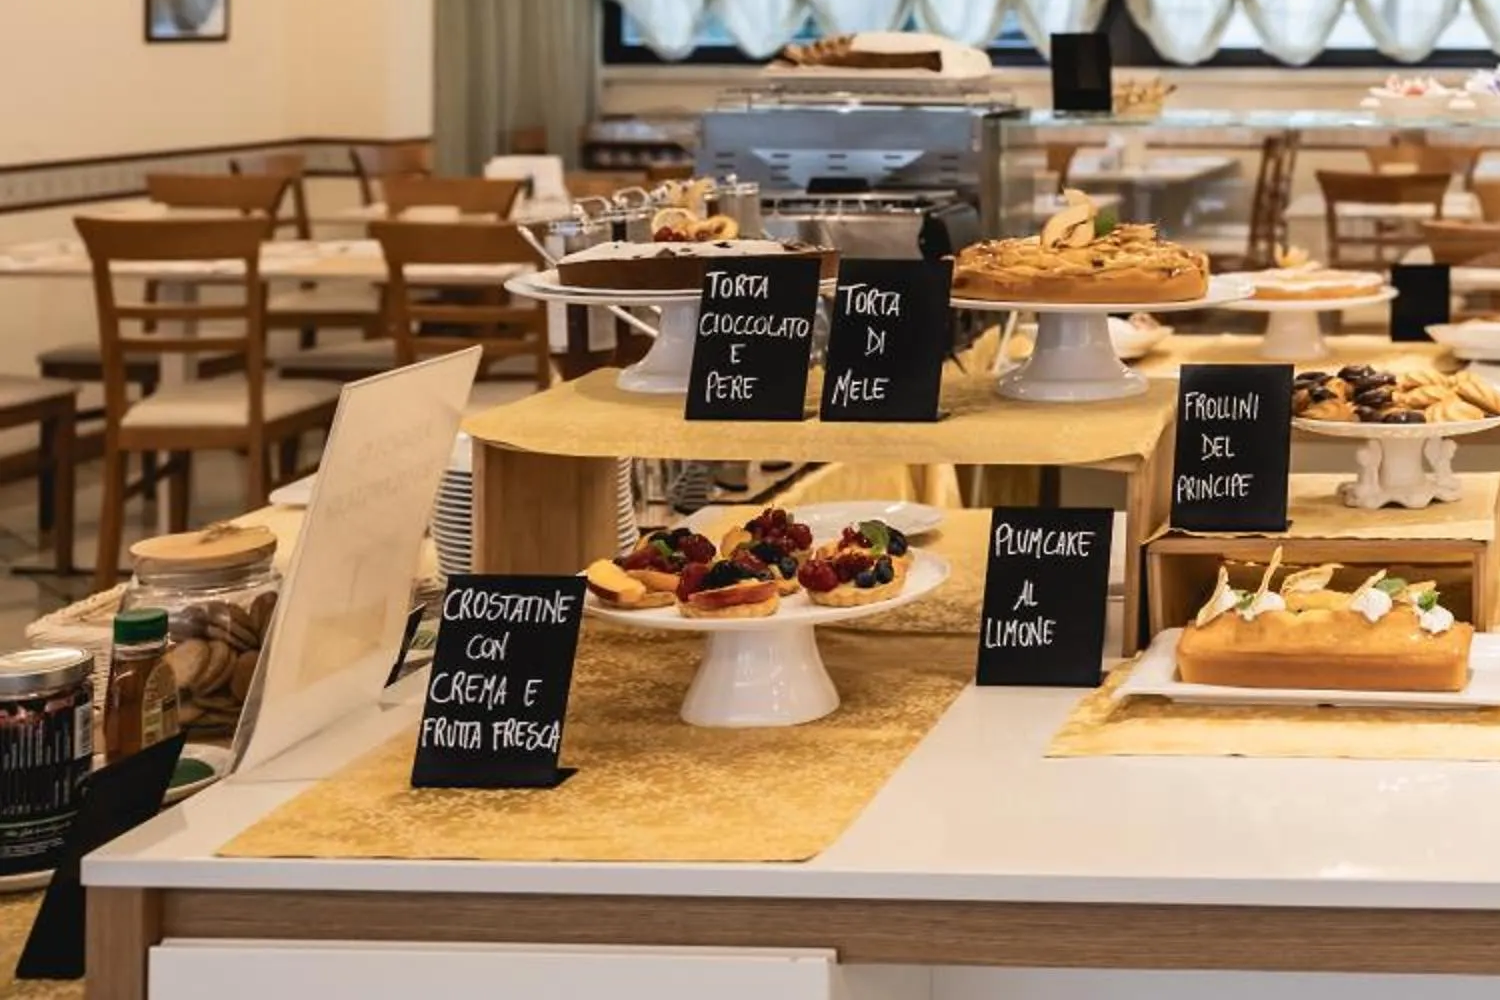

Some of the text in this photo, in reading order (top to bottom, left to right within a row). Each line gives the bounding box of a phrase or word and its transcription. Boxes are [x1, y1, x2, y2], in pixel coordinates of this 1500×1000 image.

[705, 271, 769, 299] TORTA
[837, 283, 901, 317] TORTA
[699, 312, 810, 339] CIOCCOLATO
[865, 326, 886, 356] DI
[730, 343, 745, 364] E
[705, 370, 757, 403] PERE
[831, 369, 889, 407] MELE
[1185, 391, 1259, 421] FROLLINI
[1201, 433, 1235, 461] DEL
[1177, 473, 1253, 503] PRINCIPE
[995, 522, 1095, 559] PLUMCAKE
[443, 588, 576, 624] CROSTATINE
[1013, 579, 1038, 611] AL
[466, 631, 510, 661] CON
[985, 615, 1057, 649] LIMONE
[429, 670, 543, 711] CREMA E
[421, 716, 560, 753] FRUTTA FRESCA
